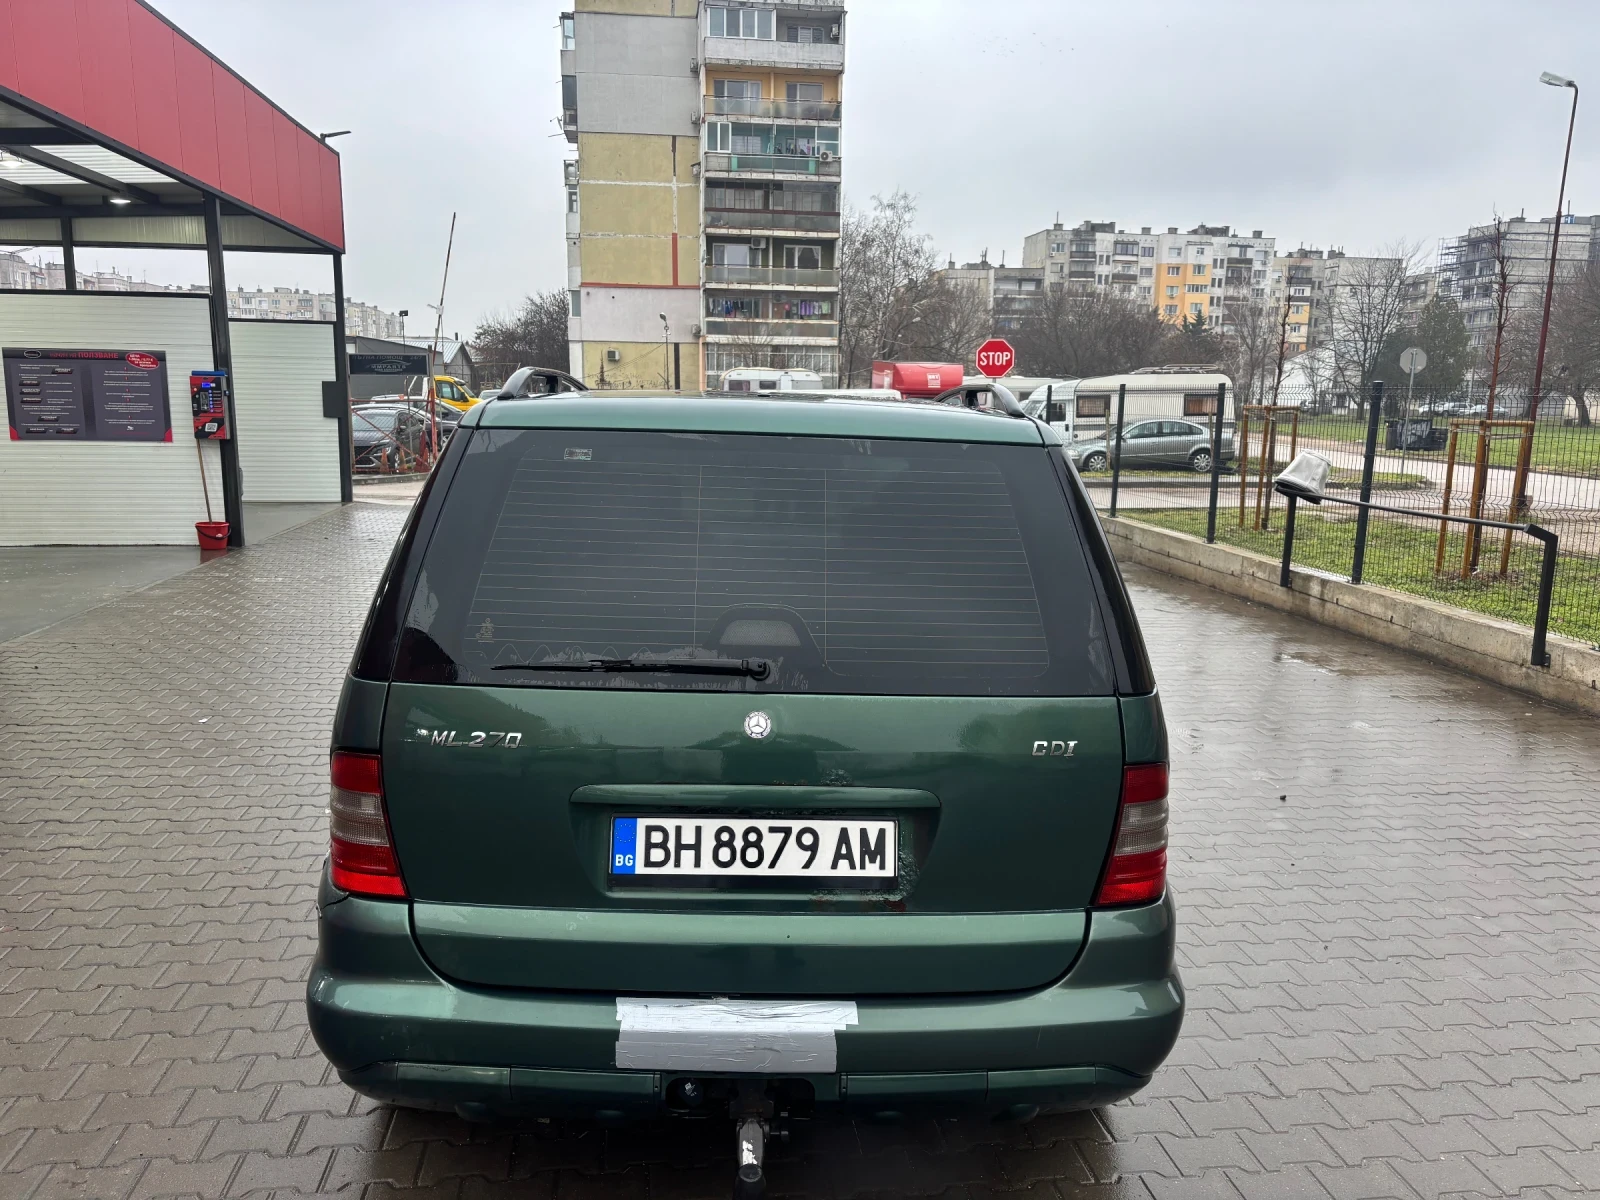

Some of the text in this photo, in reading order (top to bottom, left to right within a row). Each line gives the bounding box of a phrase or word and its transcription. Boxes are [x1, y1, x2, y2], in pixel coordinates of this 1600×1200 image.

[78, 351, 119, 359] ПОЛЗВАНЕ
[980, 351, 1011, 366] STOP
[431, 730, 522, 748] ML 270
[1032, 740, 1078, 757] CDI
[643, 825, 886, 870] BH 8879 AM
[615, 854, 633, 867] BG
